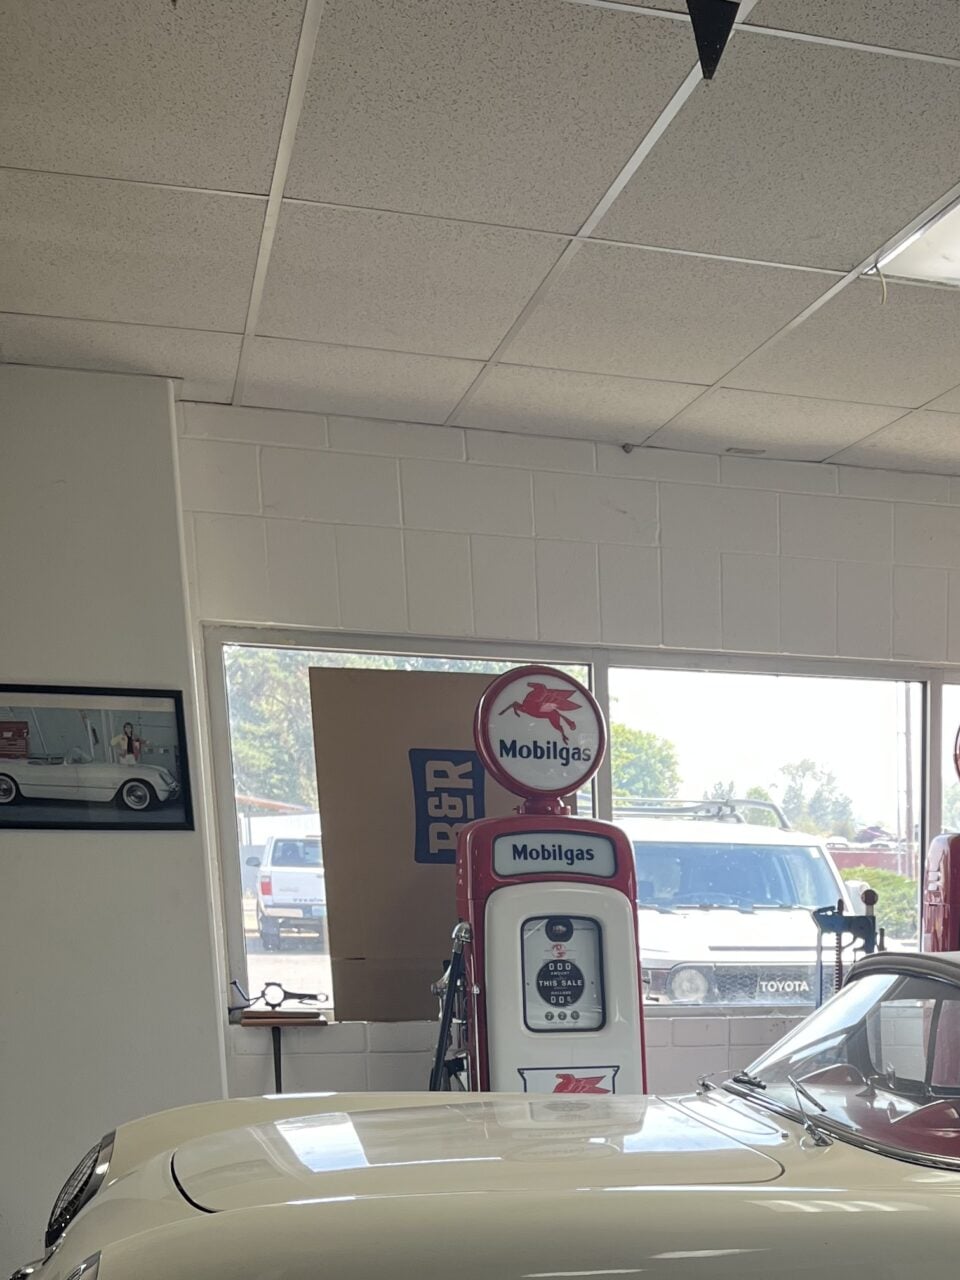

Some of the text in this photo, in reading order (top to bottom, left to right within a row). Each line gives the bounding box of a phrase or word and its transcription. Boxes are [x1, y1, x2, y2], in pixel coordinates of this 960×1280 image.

[500, 739, 591, 766] Mobilgas
[512, 844, 594, 865] Mobilgas
[760, 980, 809, 991] TOYOTA
